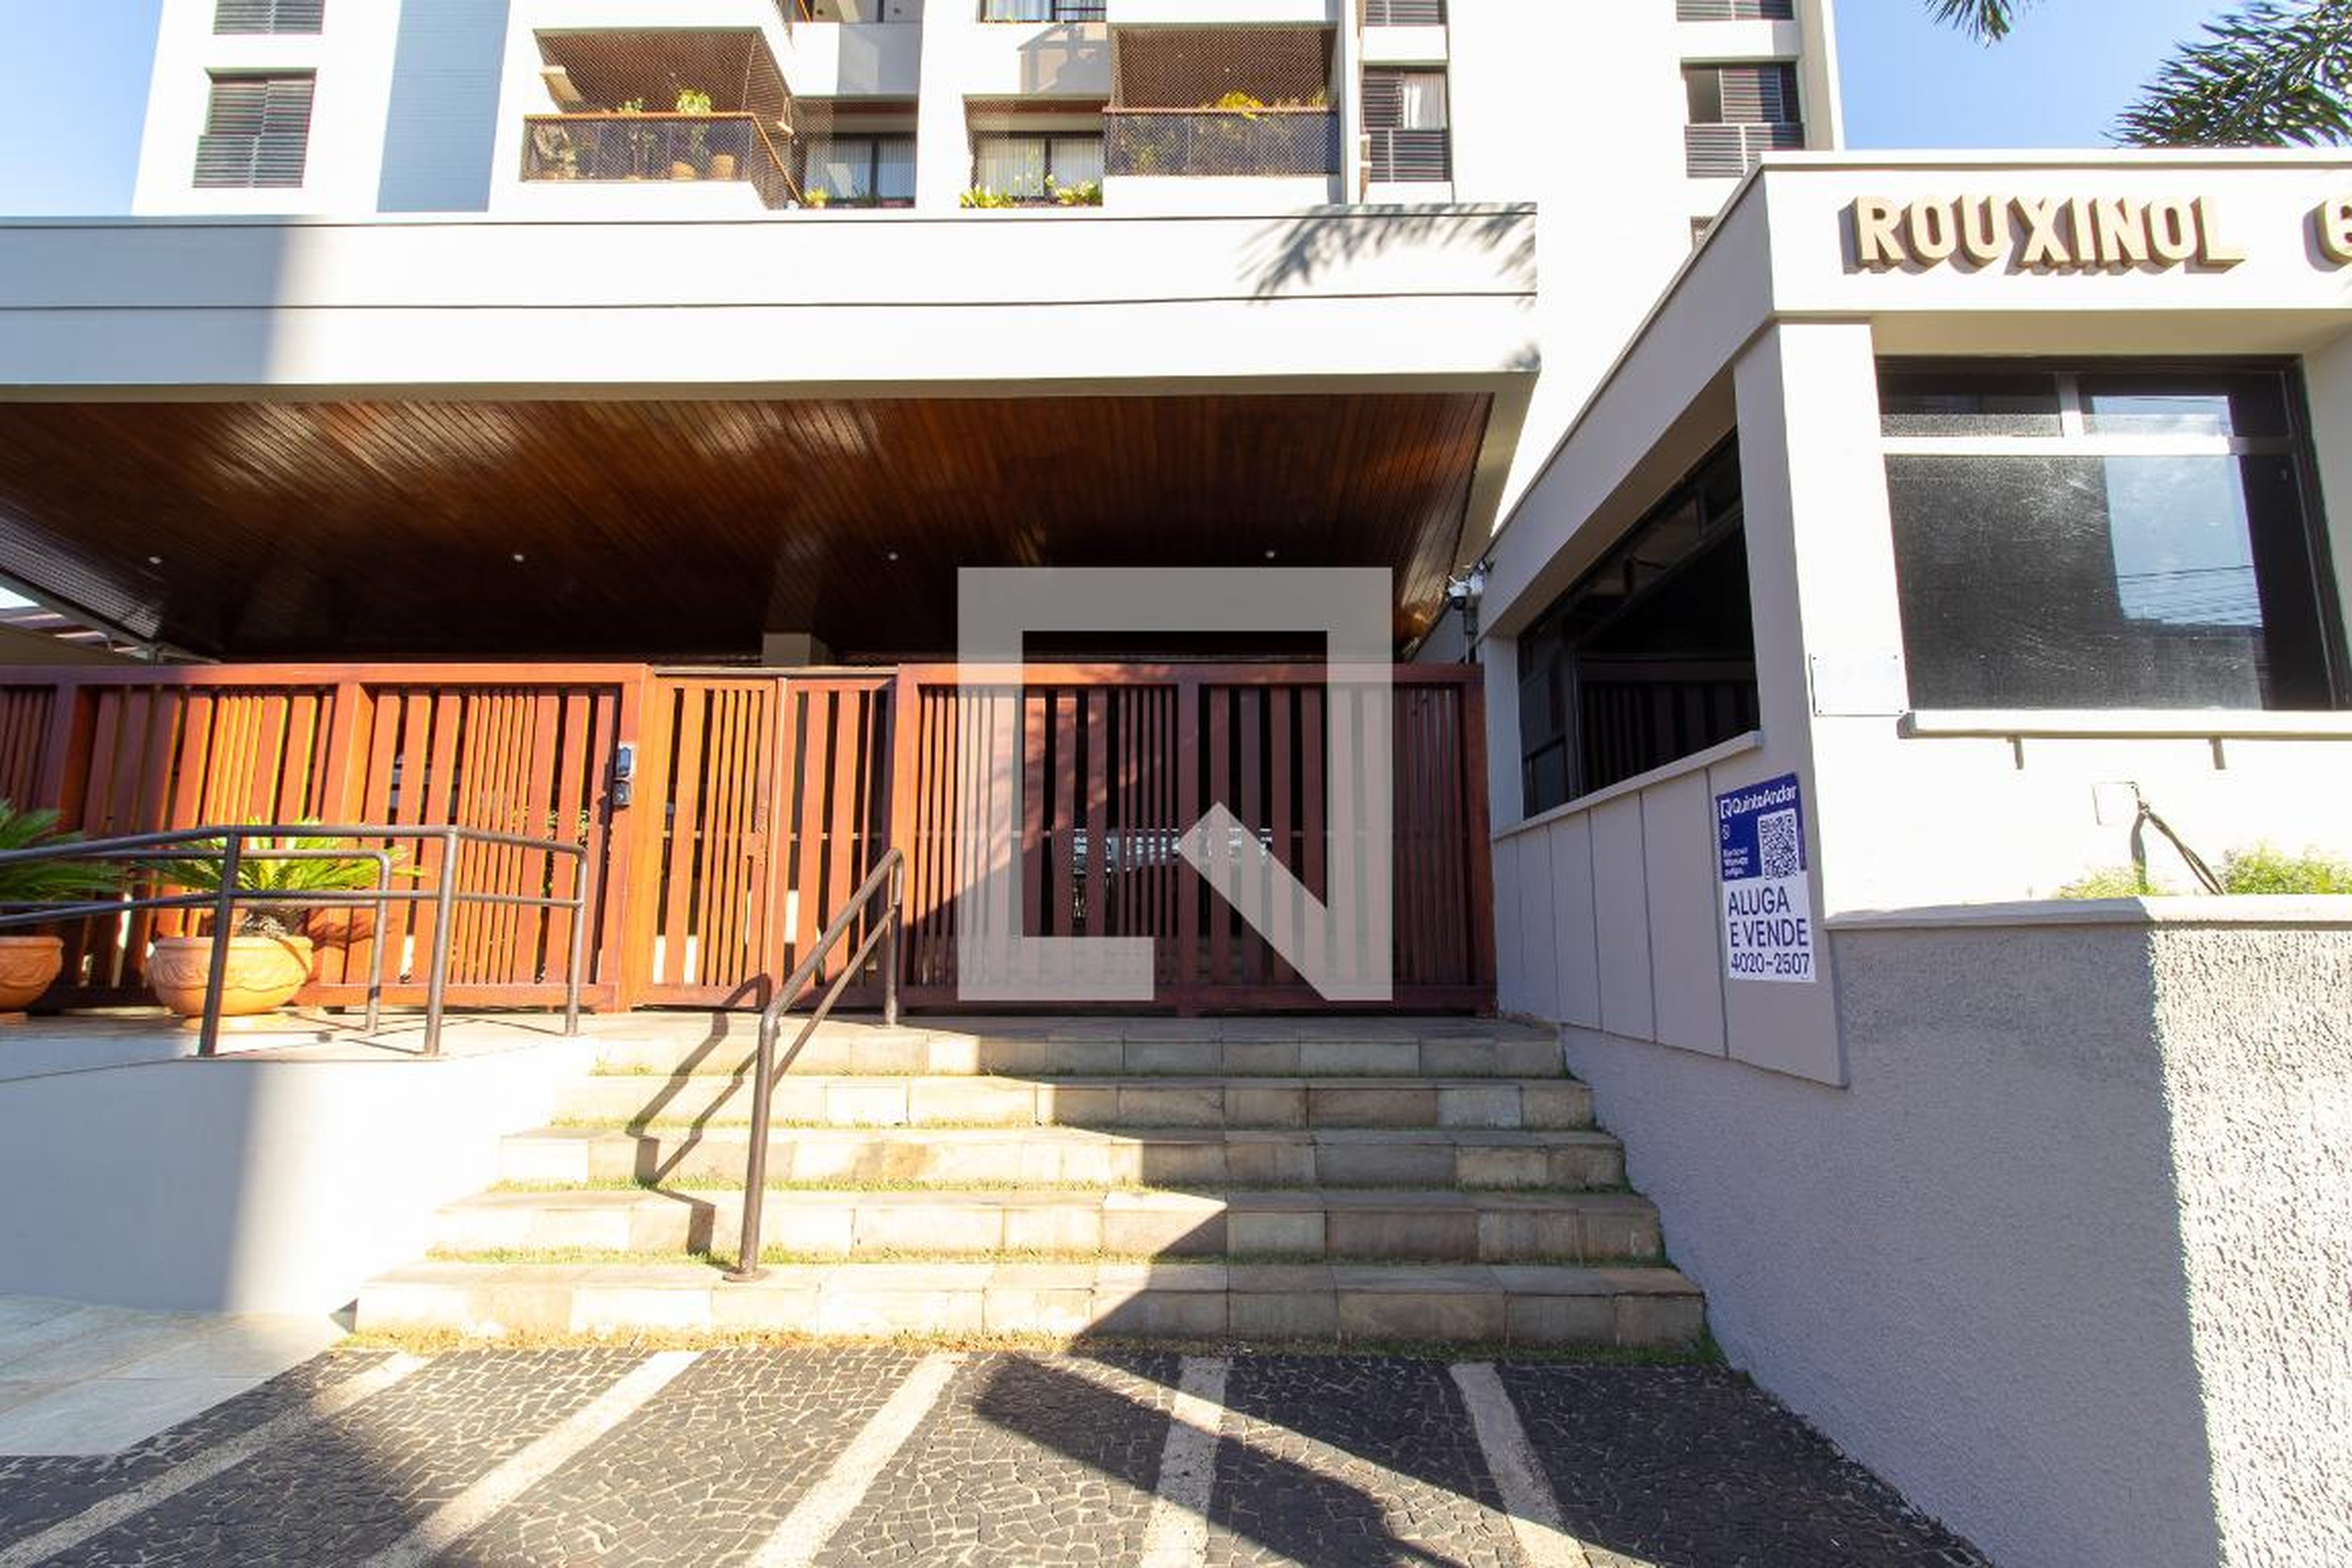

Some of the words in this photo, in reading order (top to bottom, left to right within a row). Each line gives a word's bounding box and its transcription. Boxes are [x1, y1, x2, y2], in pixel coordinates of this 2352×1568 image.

[1846, 194, 2247, 268] ROUXINOL
[1732, 785, 1797, 814] QuintoAndar
[1728, 886, 1791, 916] ALUGA
[1730, 922, 1740, 948] E
[1743, 918, 1809, 948] VENDE
[1730, 952, 1811, 975] 4020-2507
